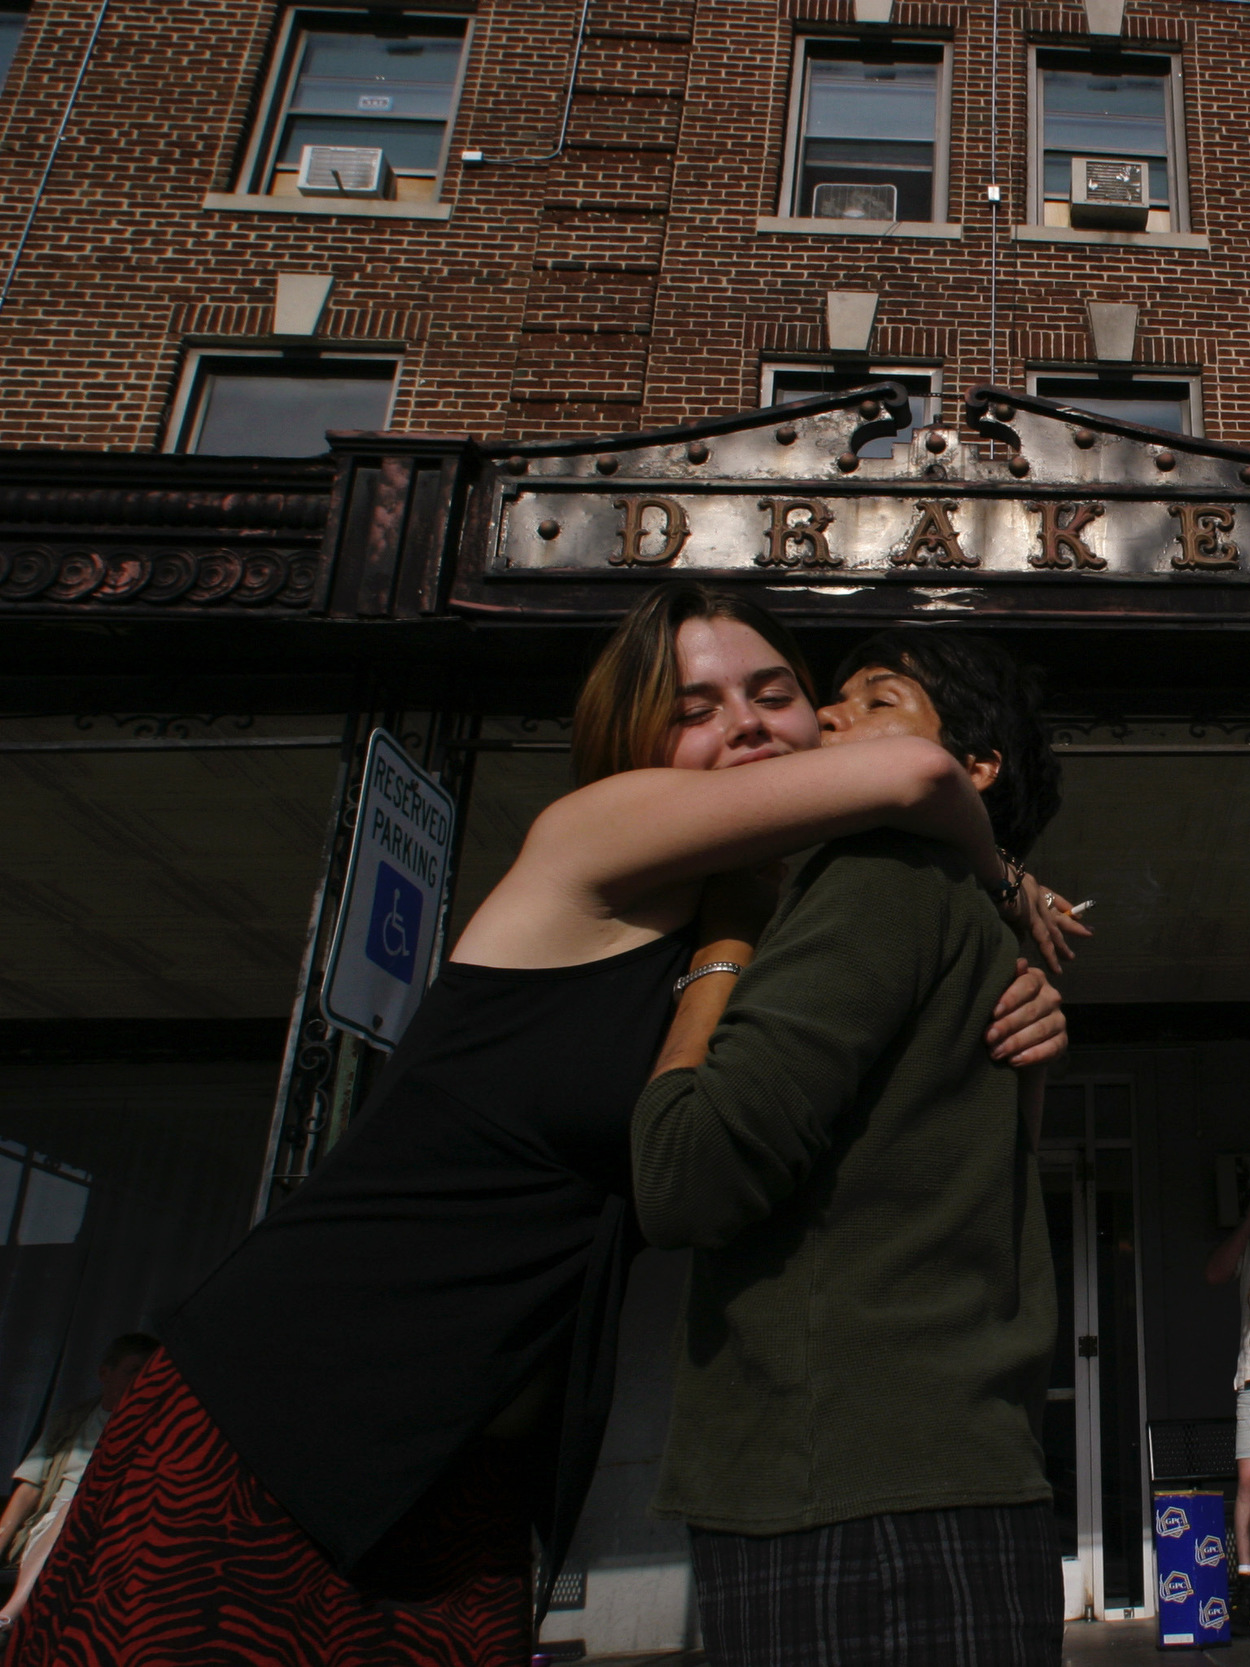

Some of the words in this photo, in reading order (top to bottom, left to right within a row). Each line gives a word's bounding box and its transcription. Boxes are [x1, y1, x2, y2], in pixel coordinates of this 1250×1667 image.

[608, 498, 1240, 571] DRAKE
[374, 755, 447, 847] RESERVED
[372, 807, 438, 888] PARKING
[1165, 1517, 1183, 1525] GPC
[1203, 1546, 1219, 1554] GPC
[1168, 1582, 1187, 1590] GPC
[1207, 1608, 1224, 1616] GPC
